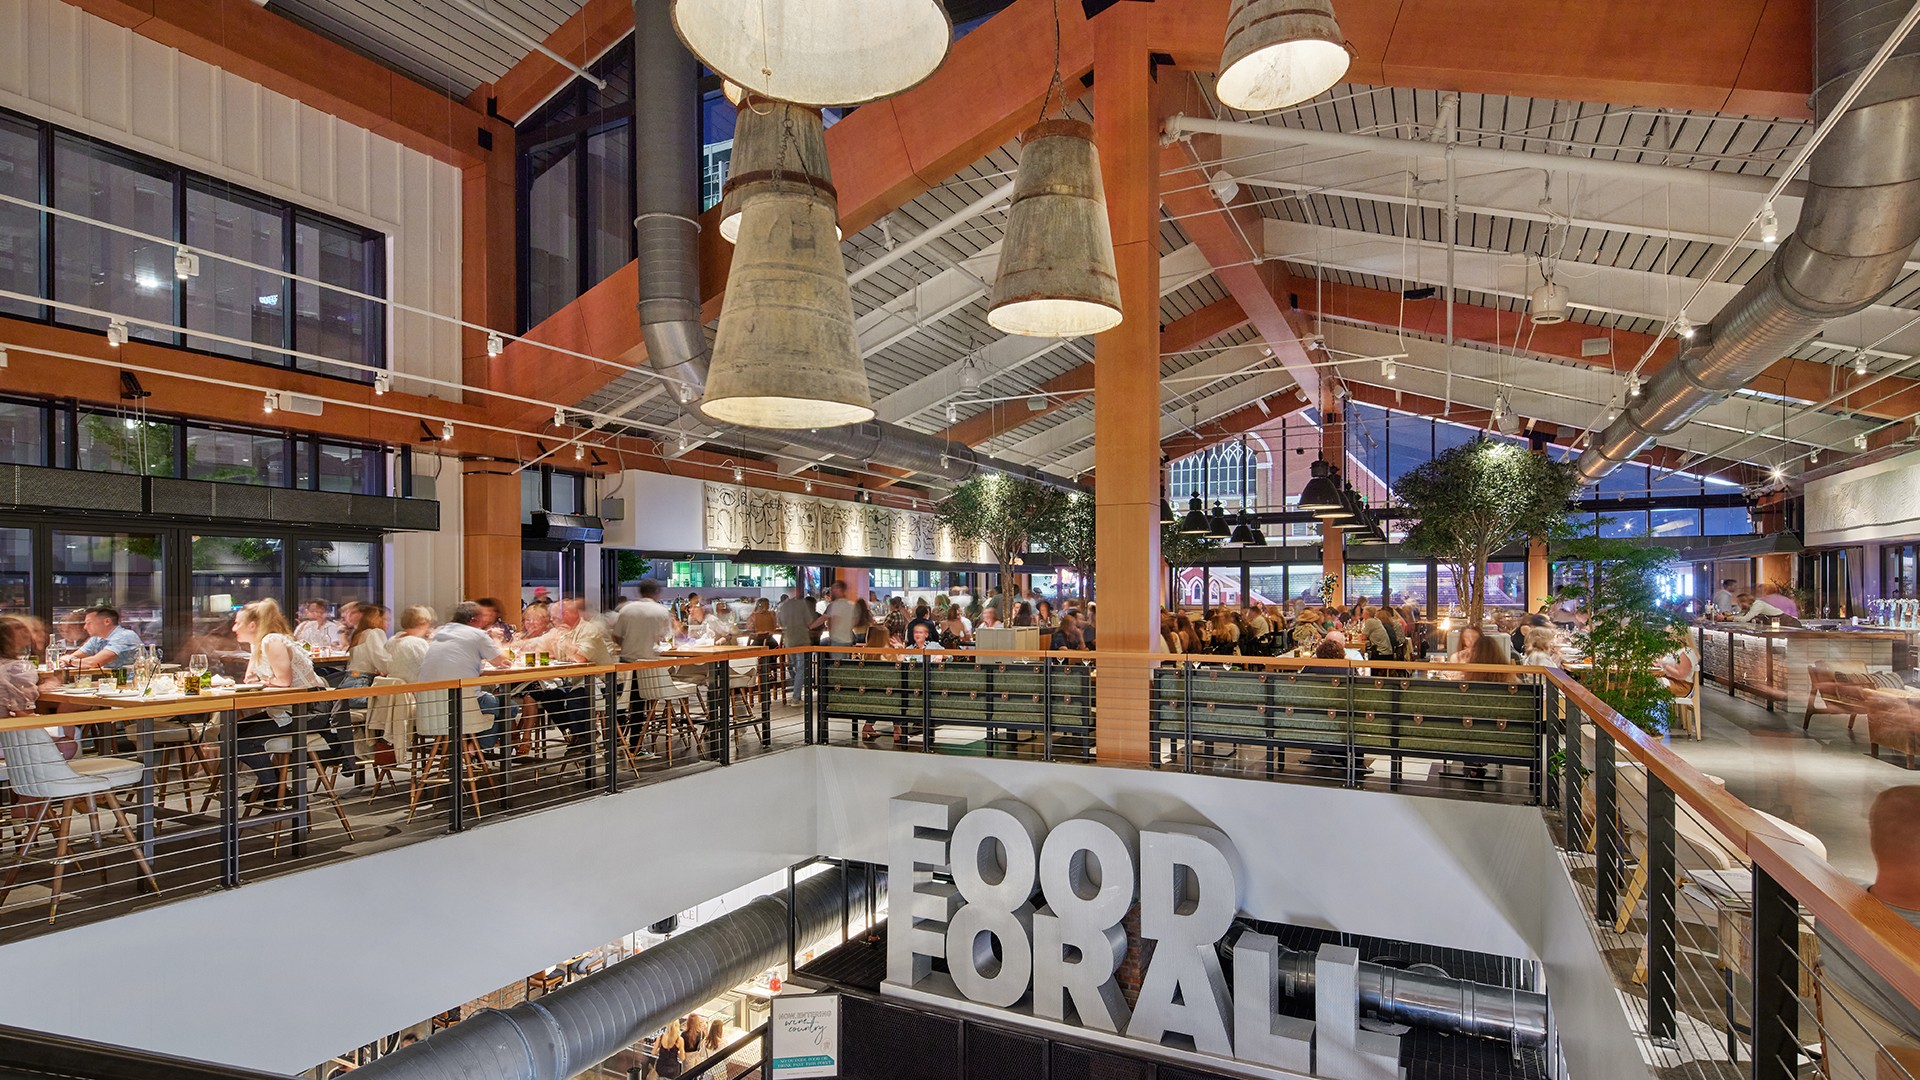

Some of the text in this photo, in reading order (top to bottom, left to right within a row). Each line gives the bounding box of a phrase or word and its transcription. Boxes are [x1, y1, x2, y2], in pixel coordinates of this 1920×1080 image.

[887, 791, 1246, 941] FOOD
[788, 1016, 828, 1046] country
[886, 883, 1402, 1080] FOR ALL
